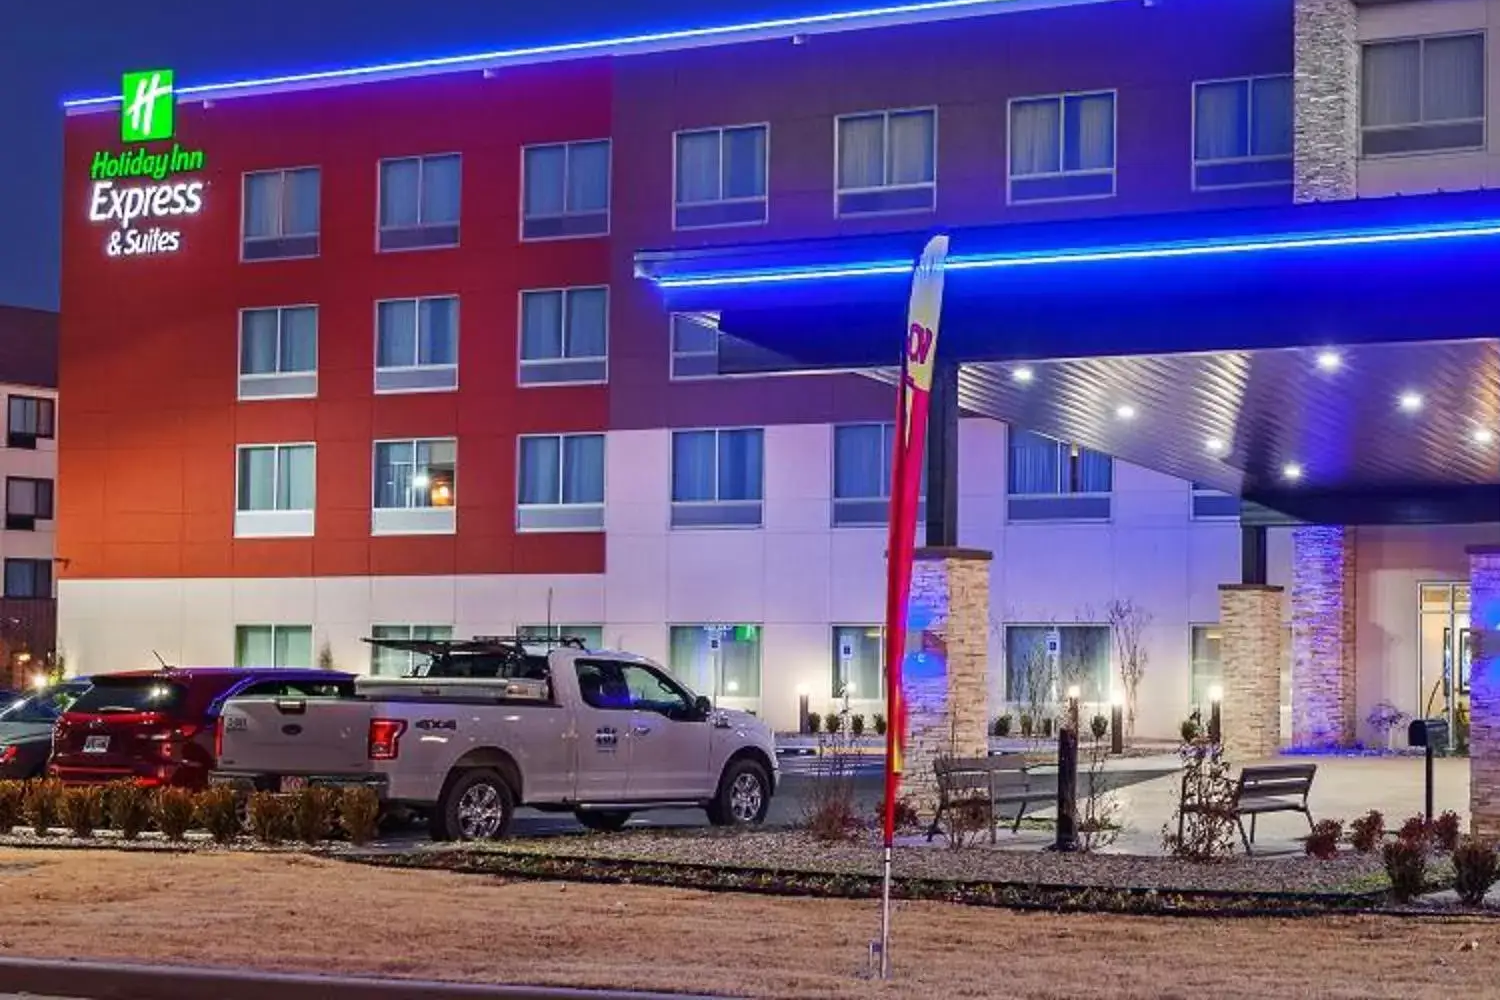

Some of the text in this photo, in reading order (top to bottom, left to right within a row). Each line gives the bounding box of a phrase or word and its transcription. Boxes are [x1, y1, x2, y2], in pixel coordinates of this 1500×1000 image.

[91, 143, 204, 180] Holiday Inn
[89, 181, 203, 229] Express
[107, 227, 181, 256] & Suites
